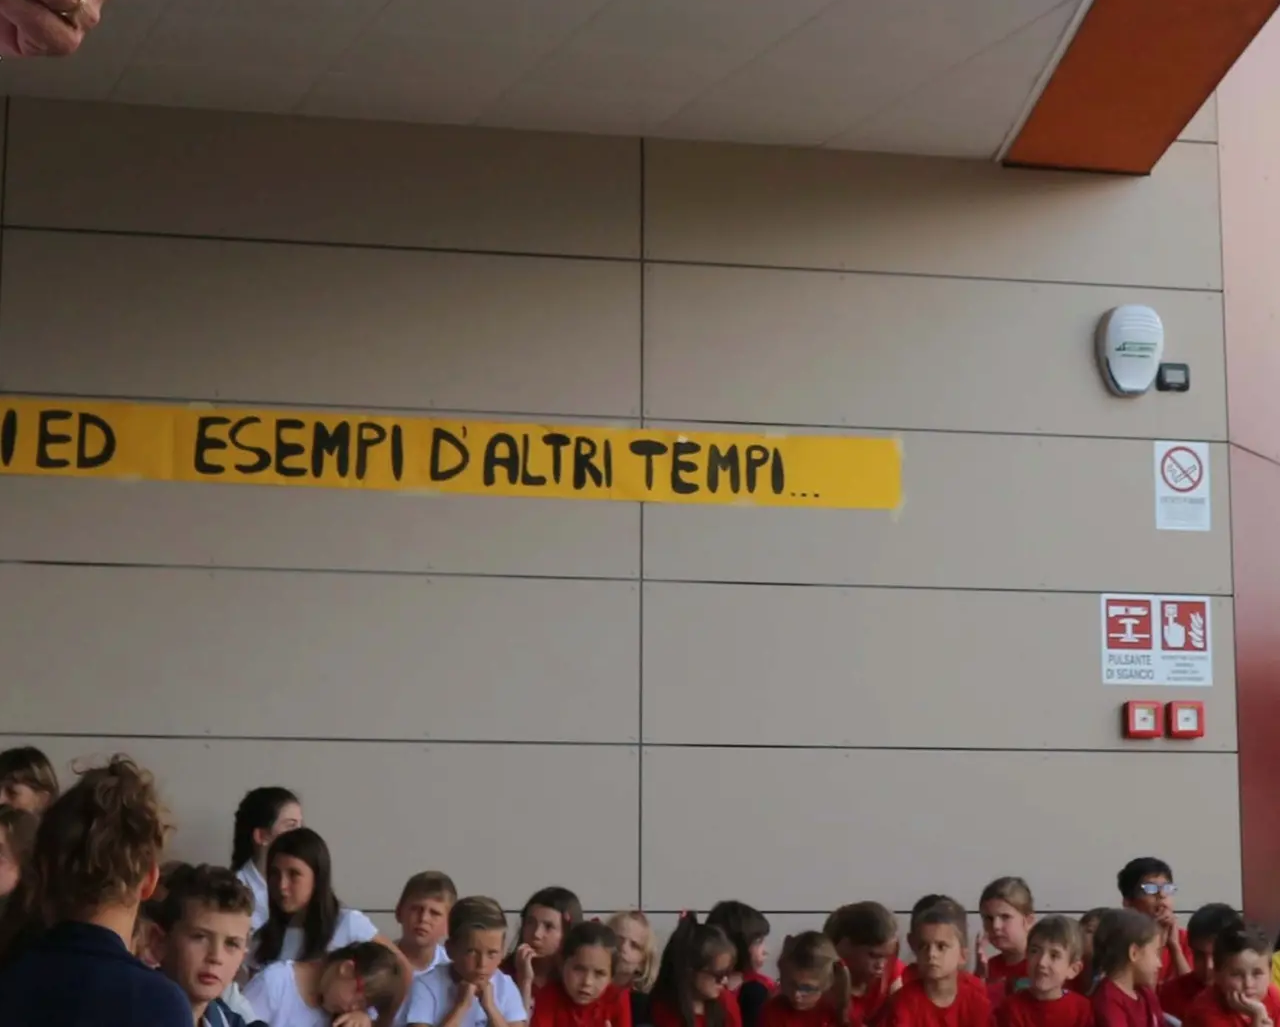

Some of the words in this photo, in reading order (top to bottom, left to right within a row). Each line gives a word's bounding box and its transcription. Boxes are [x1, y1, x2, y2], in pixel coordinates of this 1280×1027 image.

[35, 409, 117, 469] ED
[193, 416, 404, 482] ESEMPI
[429, 425, 612, 491] D'ALTRI
[1108, 654, 1153, 666] PULSANTE
